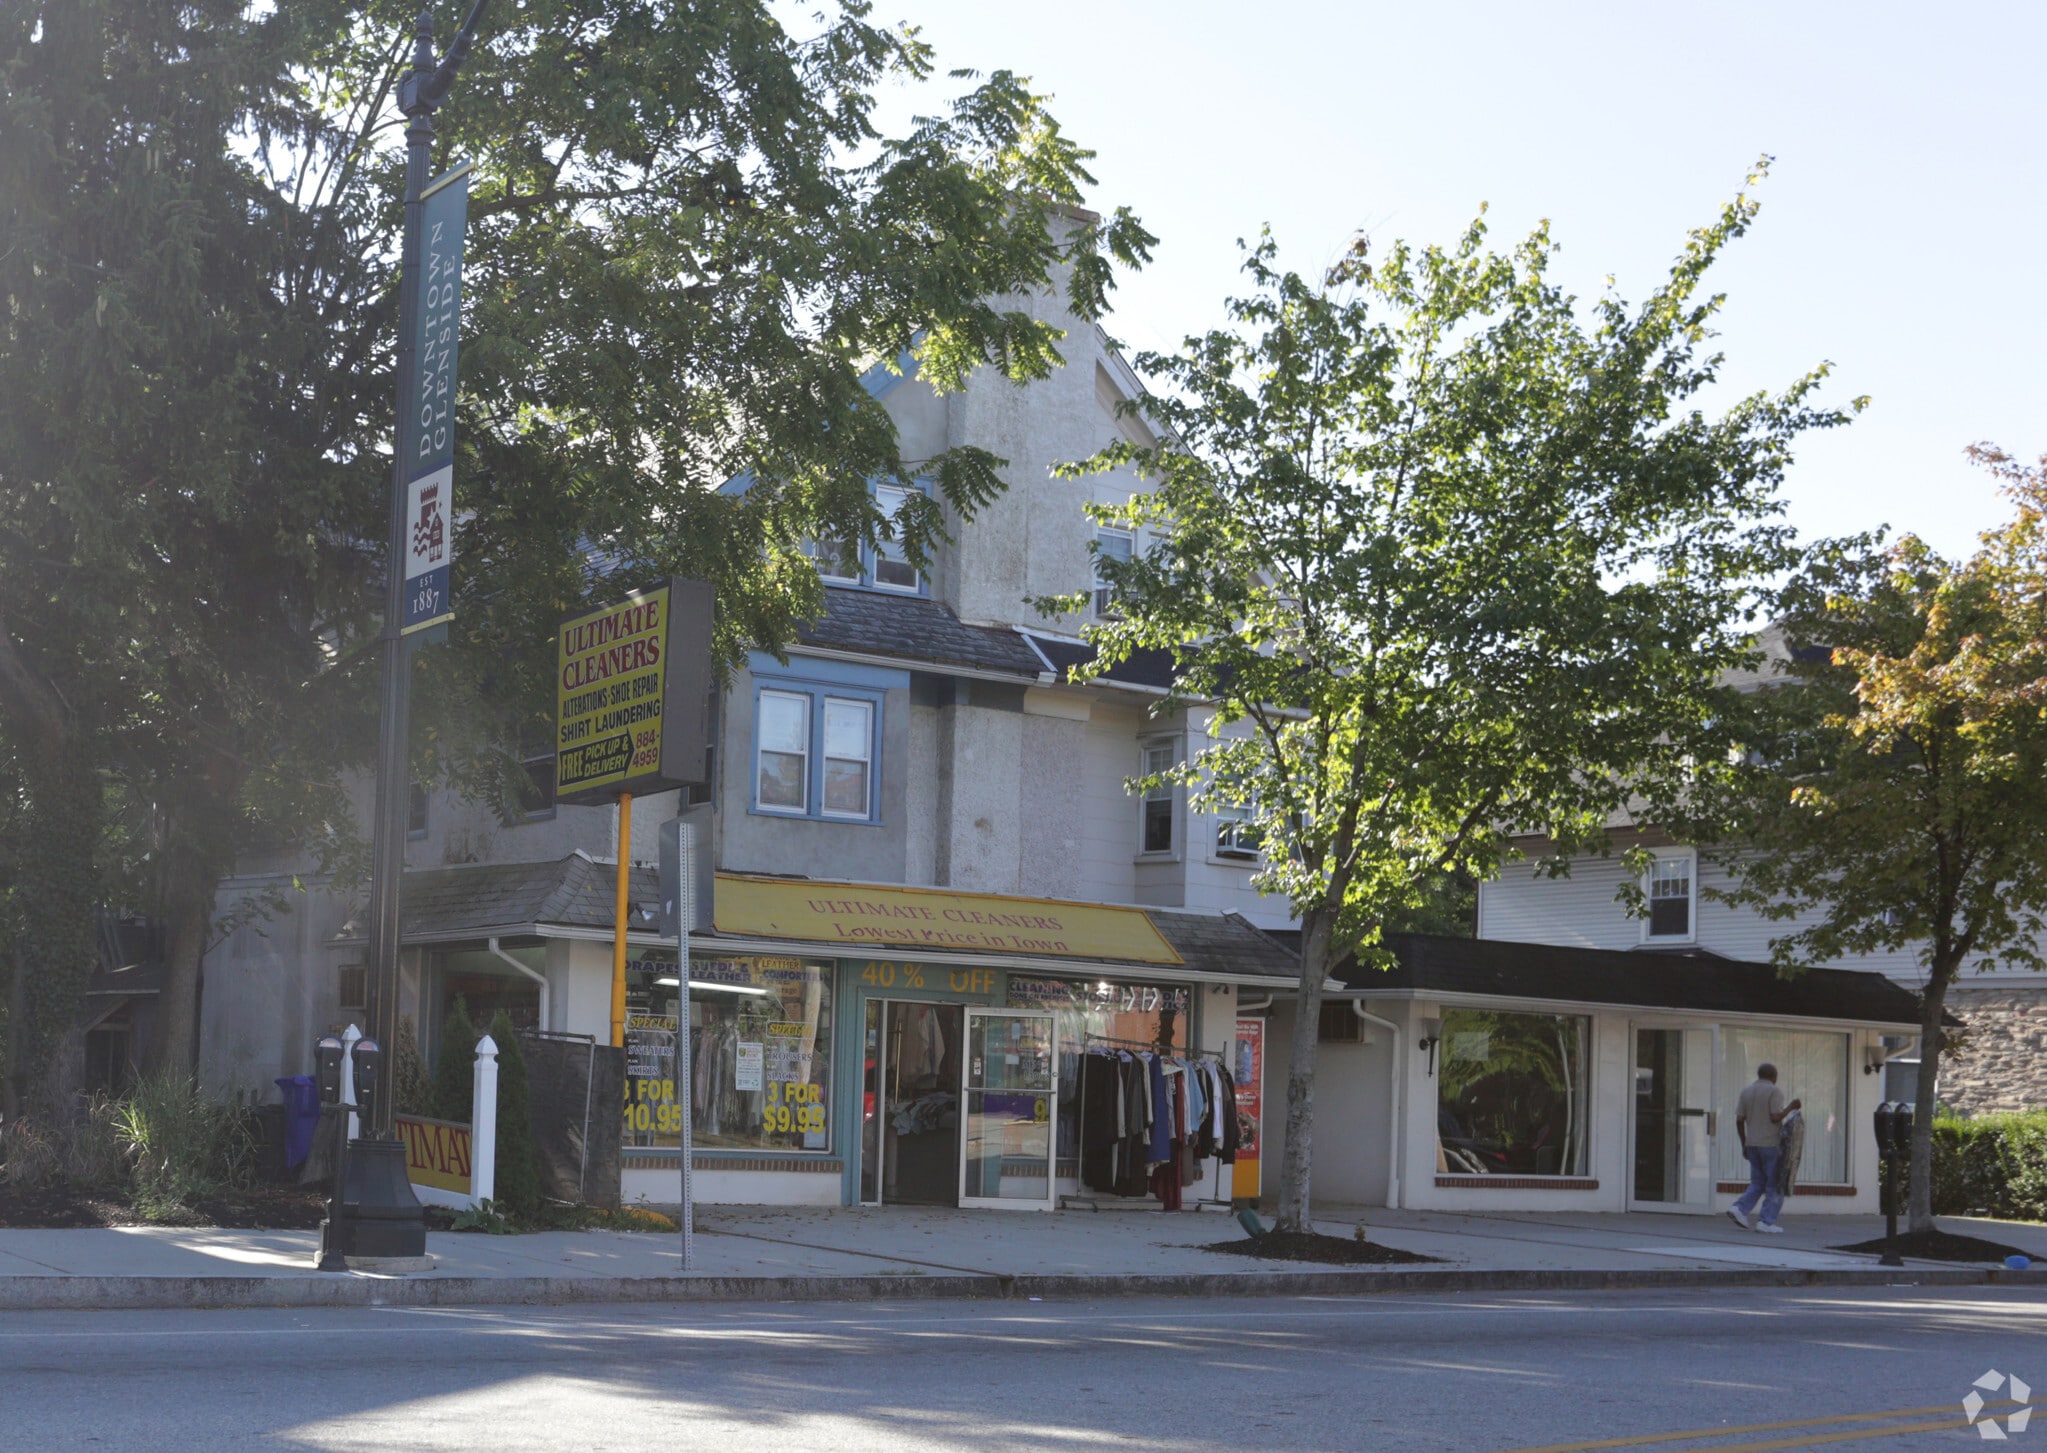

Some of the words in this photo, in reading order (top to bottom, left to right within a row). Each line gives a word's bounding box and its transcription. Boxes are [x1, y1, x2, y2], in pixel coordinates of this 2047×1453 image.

[420, 221, 443, 459] DOWNTOWN
[435, 255, 455, 451] GLENSIDE
[420, 574, 433, 588] EST
[413, 588, 439, 614] 1887
[565, 600, 659, 657] ULTIMATE
[563, 635, 660, 690] CLEANERS
[611, 681, 630, 705] SHOE
[633, 673, 658, 699] REPAIR
[561, 719, 591, 743] SHIRT
[596, 698, 660, 733] LAUNDERING
[585, 741, 606, 760] PICK
[608, 738, 619, 754] UP
[622, 736, 629, 751] &
[632, 747, 658, 768] 4959
[561, 751, 583, 780] FREE
[584, 753, 628, 777] DELIVERY
[808, 900, 936, 921] ULTIMATE
[943, 908, 1064, 931] CLEANERS
[833, 923, 917, 941] Lowest
[922, 928, 977, 945] Price
[981, 932, 1004, 947] in
[1008, 935, 1069, 951] Town
[690, 970, 752, 981] LEATHER
[862, 961, 896, 987] 40
[903, 963, 925, 989] %
[949, 969, 998, 993] OFF
[630, 1016, 676, 1030] SPECIAL
[637, 1079, 675, 1101] FOR
[768, 1081, 779, 1103] 3
[785, 1082, 821, 1104] FOR
[624, 1104, 682, 1131] 10.95
[763, 1105, 824, 1134] $9.95
